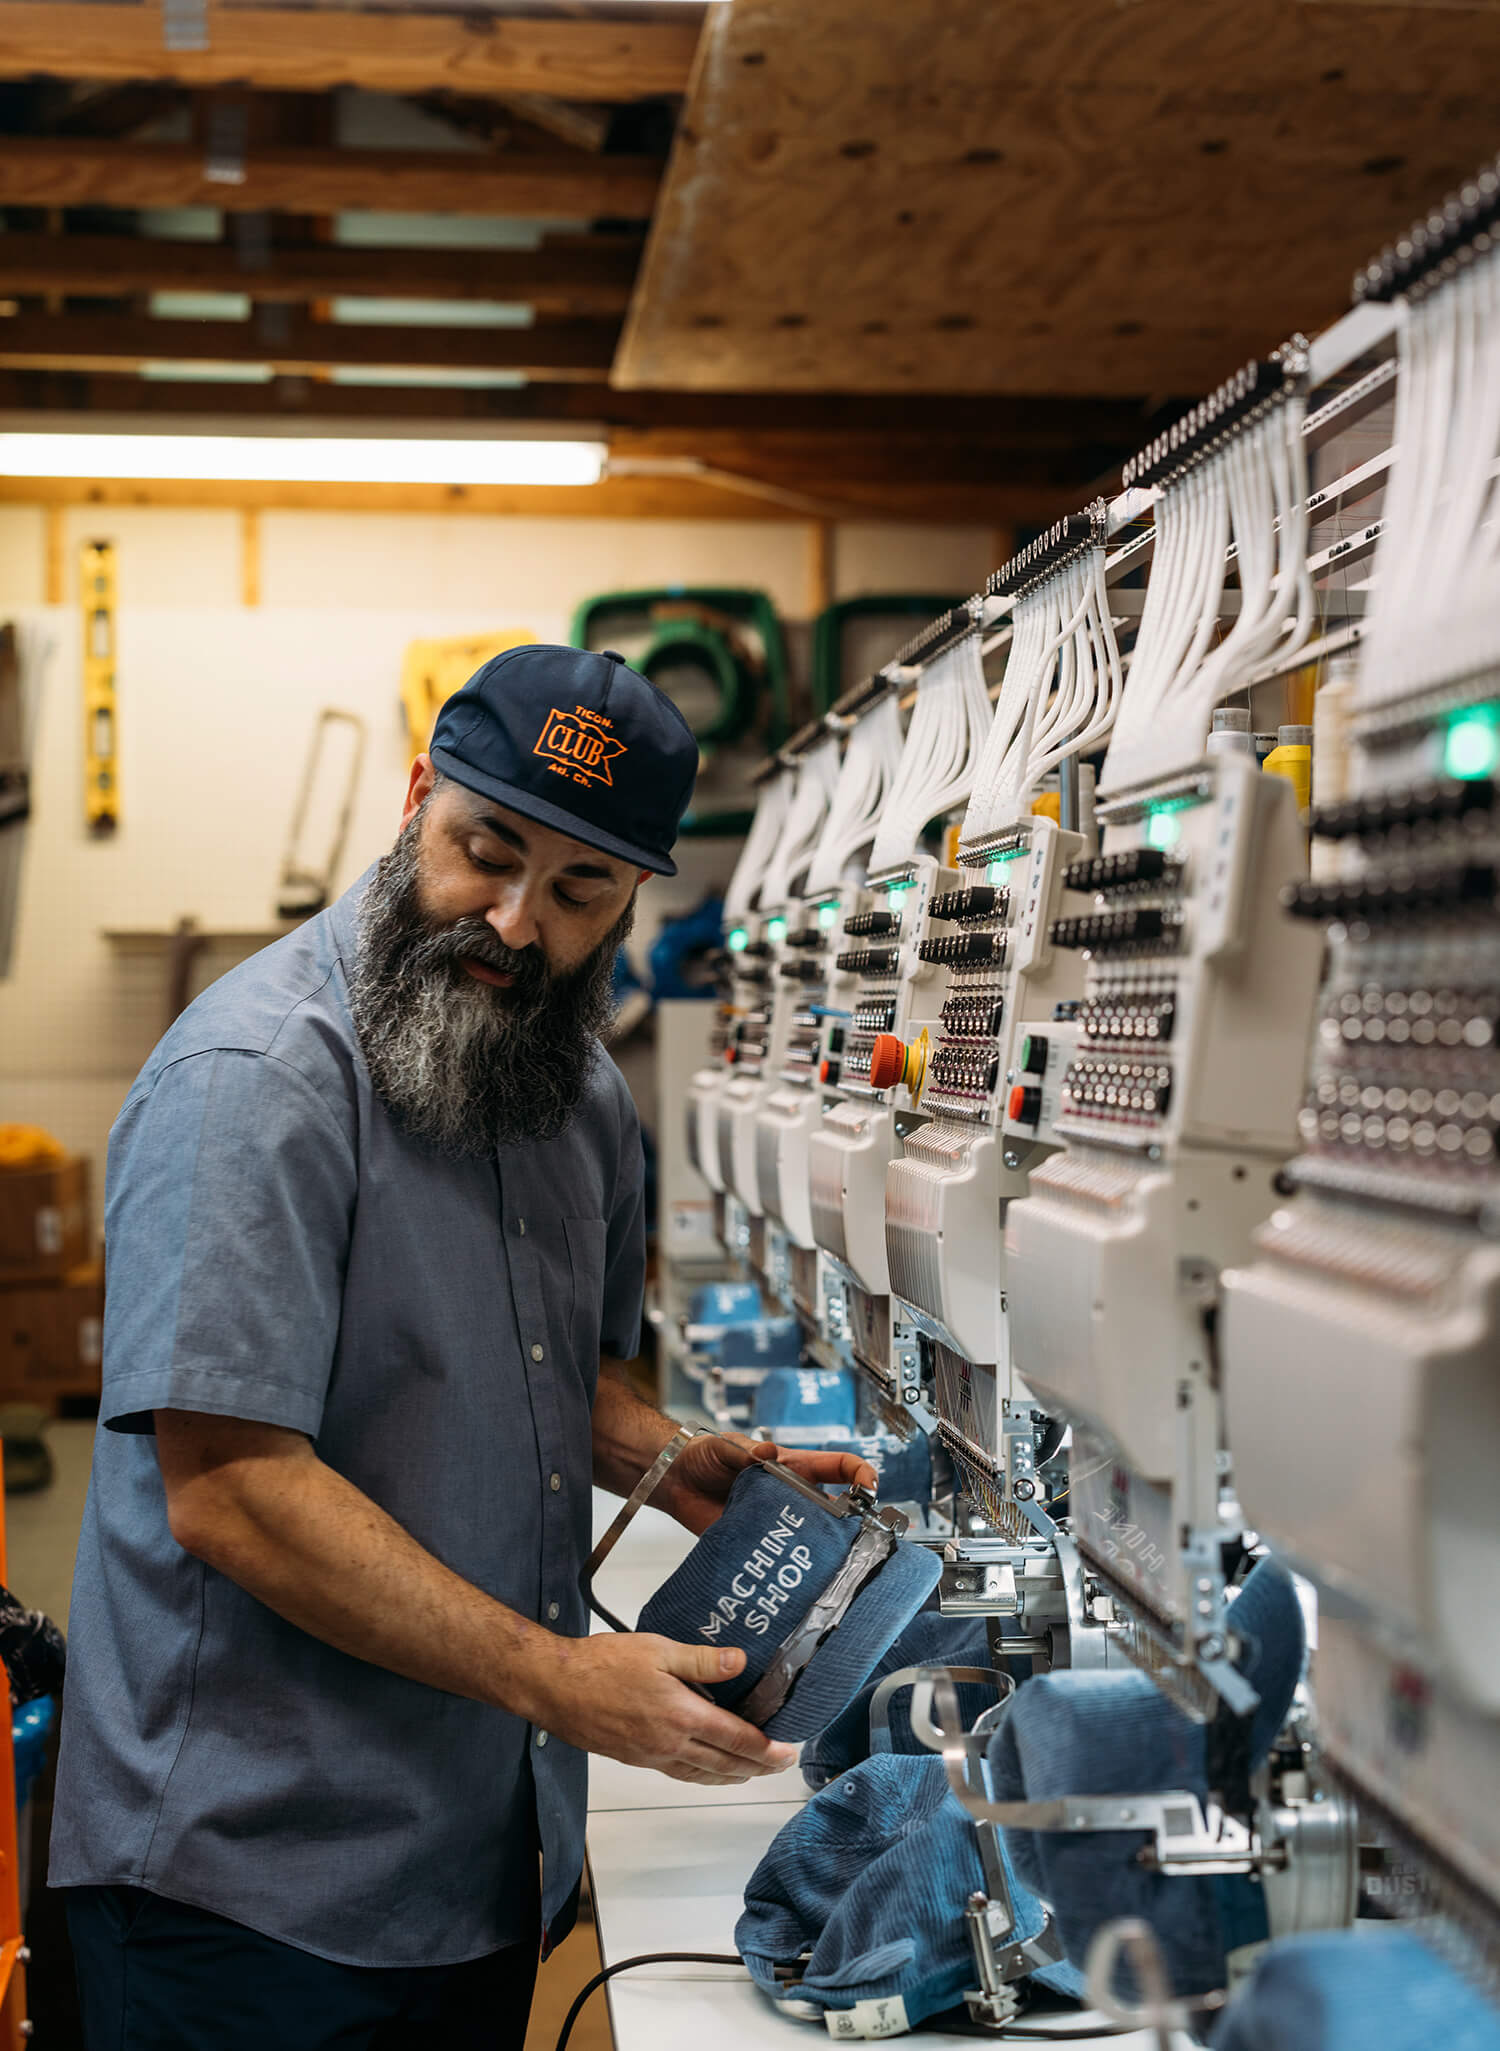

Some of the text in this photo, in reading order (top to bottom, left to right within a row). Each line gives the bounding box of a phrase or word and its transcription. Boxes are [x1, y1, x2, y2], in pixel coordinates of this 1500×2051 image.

[547, 724, 605, 766] CLUB
[575, 705, 614, 729] TICON.
[697, 1505, 805, 1643] MACHINE
[744, 1545, 812, 1635] SHOP
